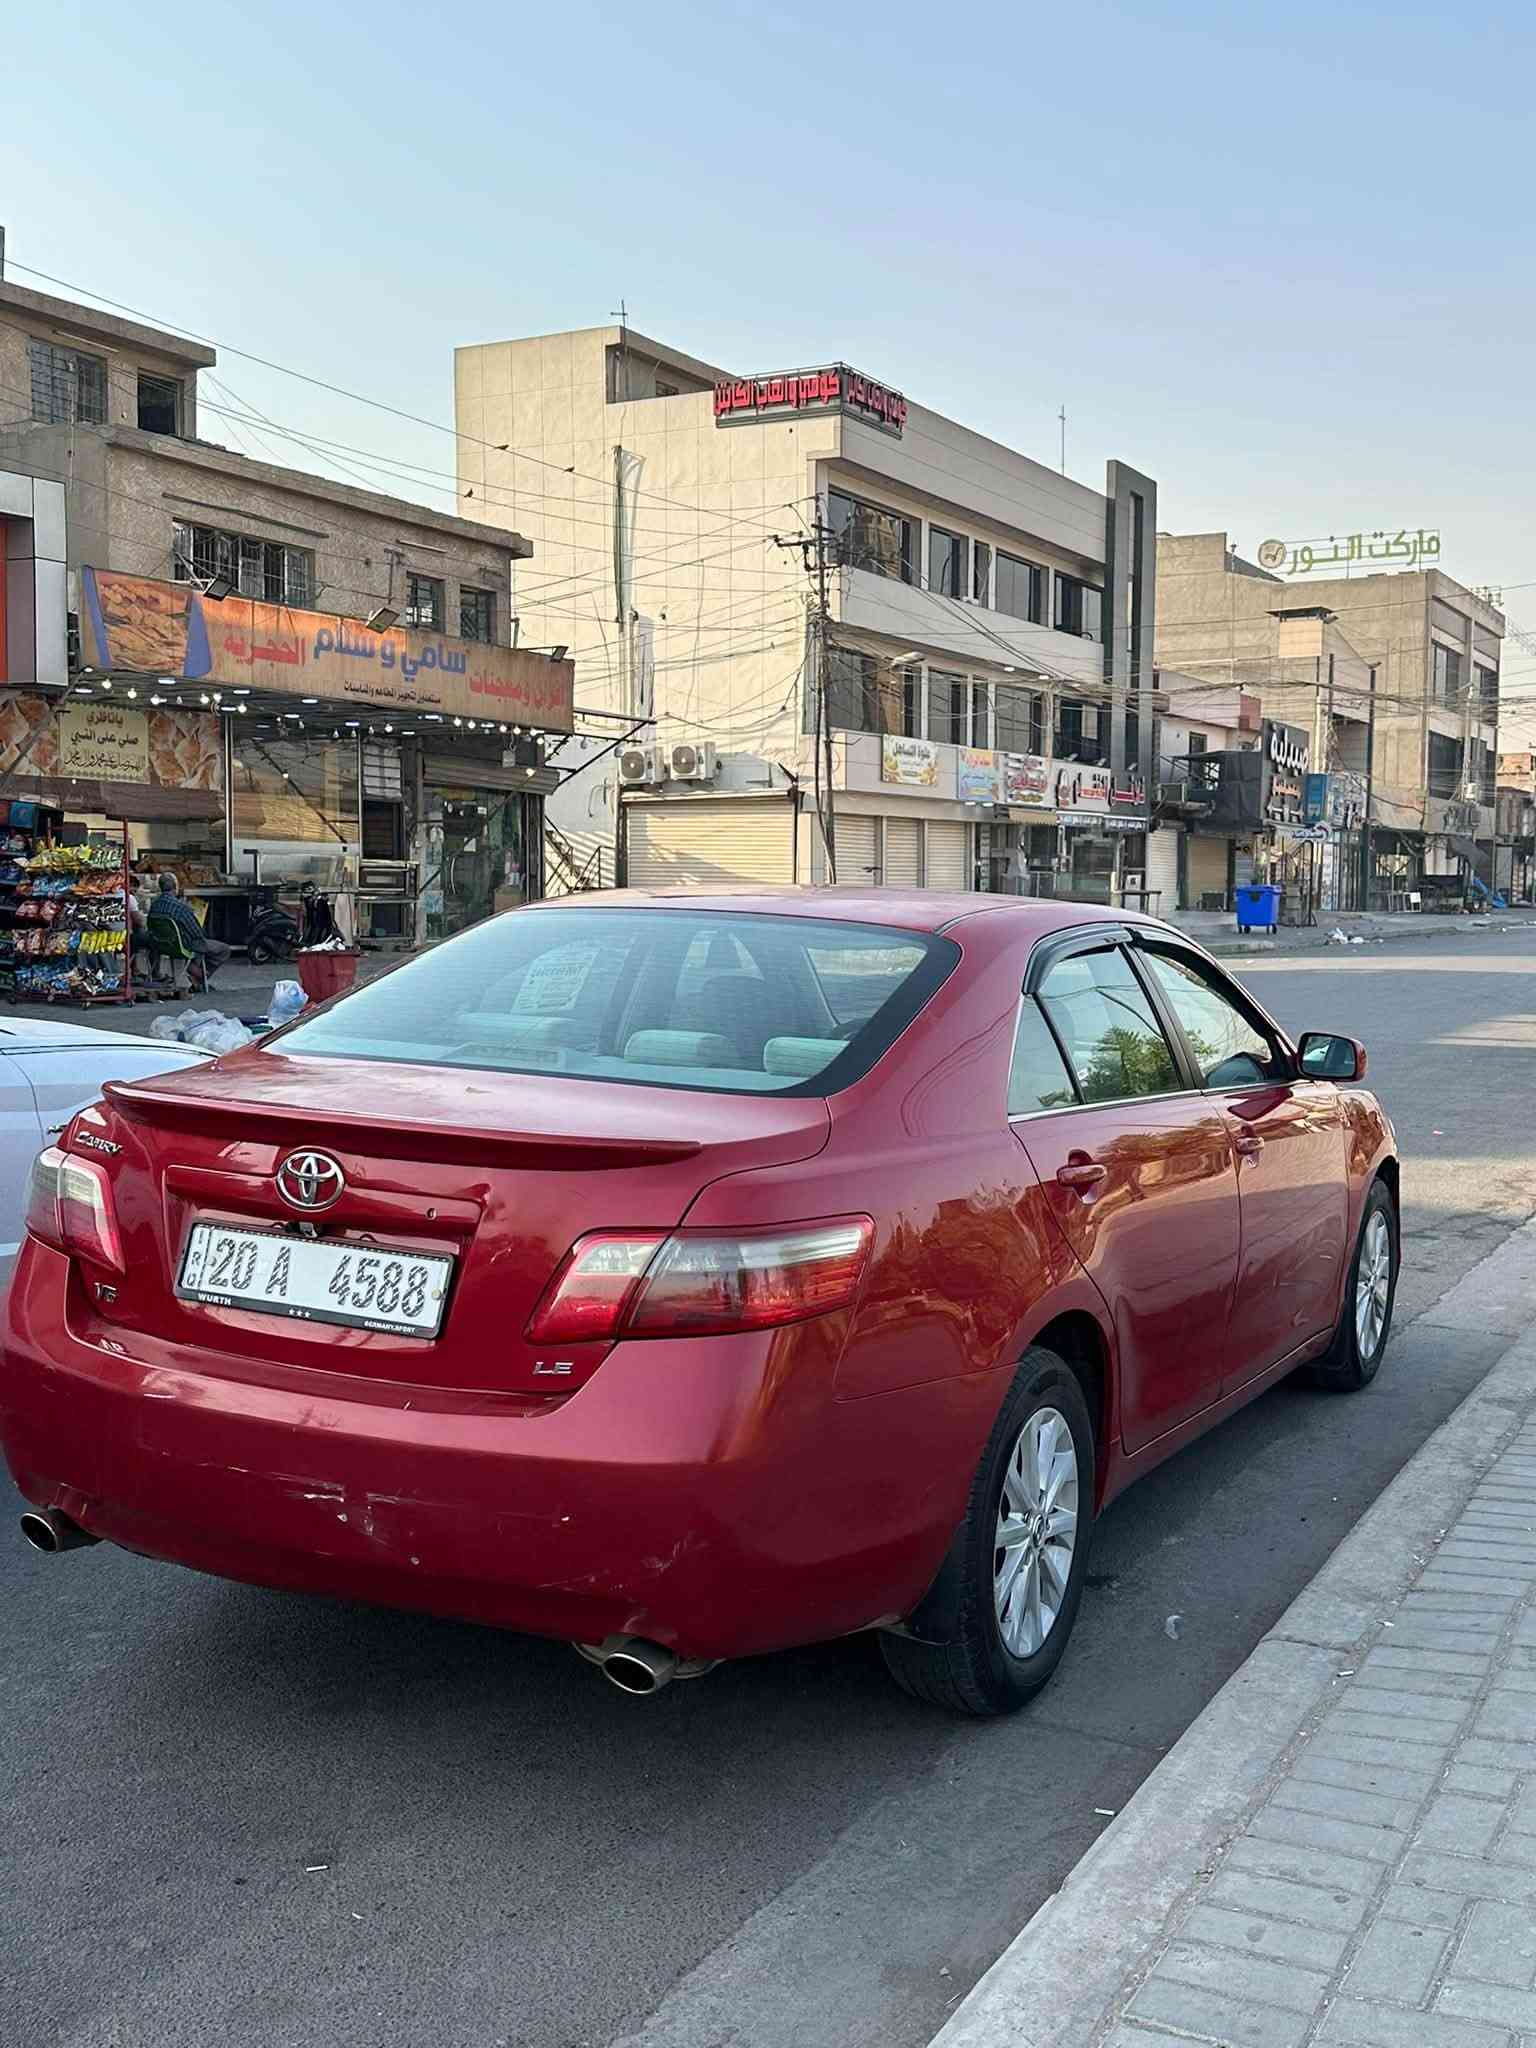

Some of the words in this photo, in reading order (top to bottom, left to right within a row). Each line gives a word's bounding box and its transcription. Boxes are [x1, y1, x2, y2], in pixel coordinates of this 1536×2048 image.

[800, 368, 840, 407] كوفي
[1286, 533, 1362, 576] النور
[1369, 529, 1441, 566] ماركت
[400, 639, 466, 682] سامي
[208, 1237, 258, 1290] 20
[264, 1245, 291, 1297] A
[328, 1253, 429, 1318] 4588
[197, 1292, 232, 1307] WURTH
[532, 1361, 574, 1376] LE
